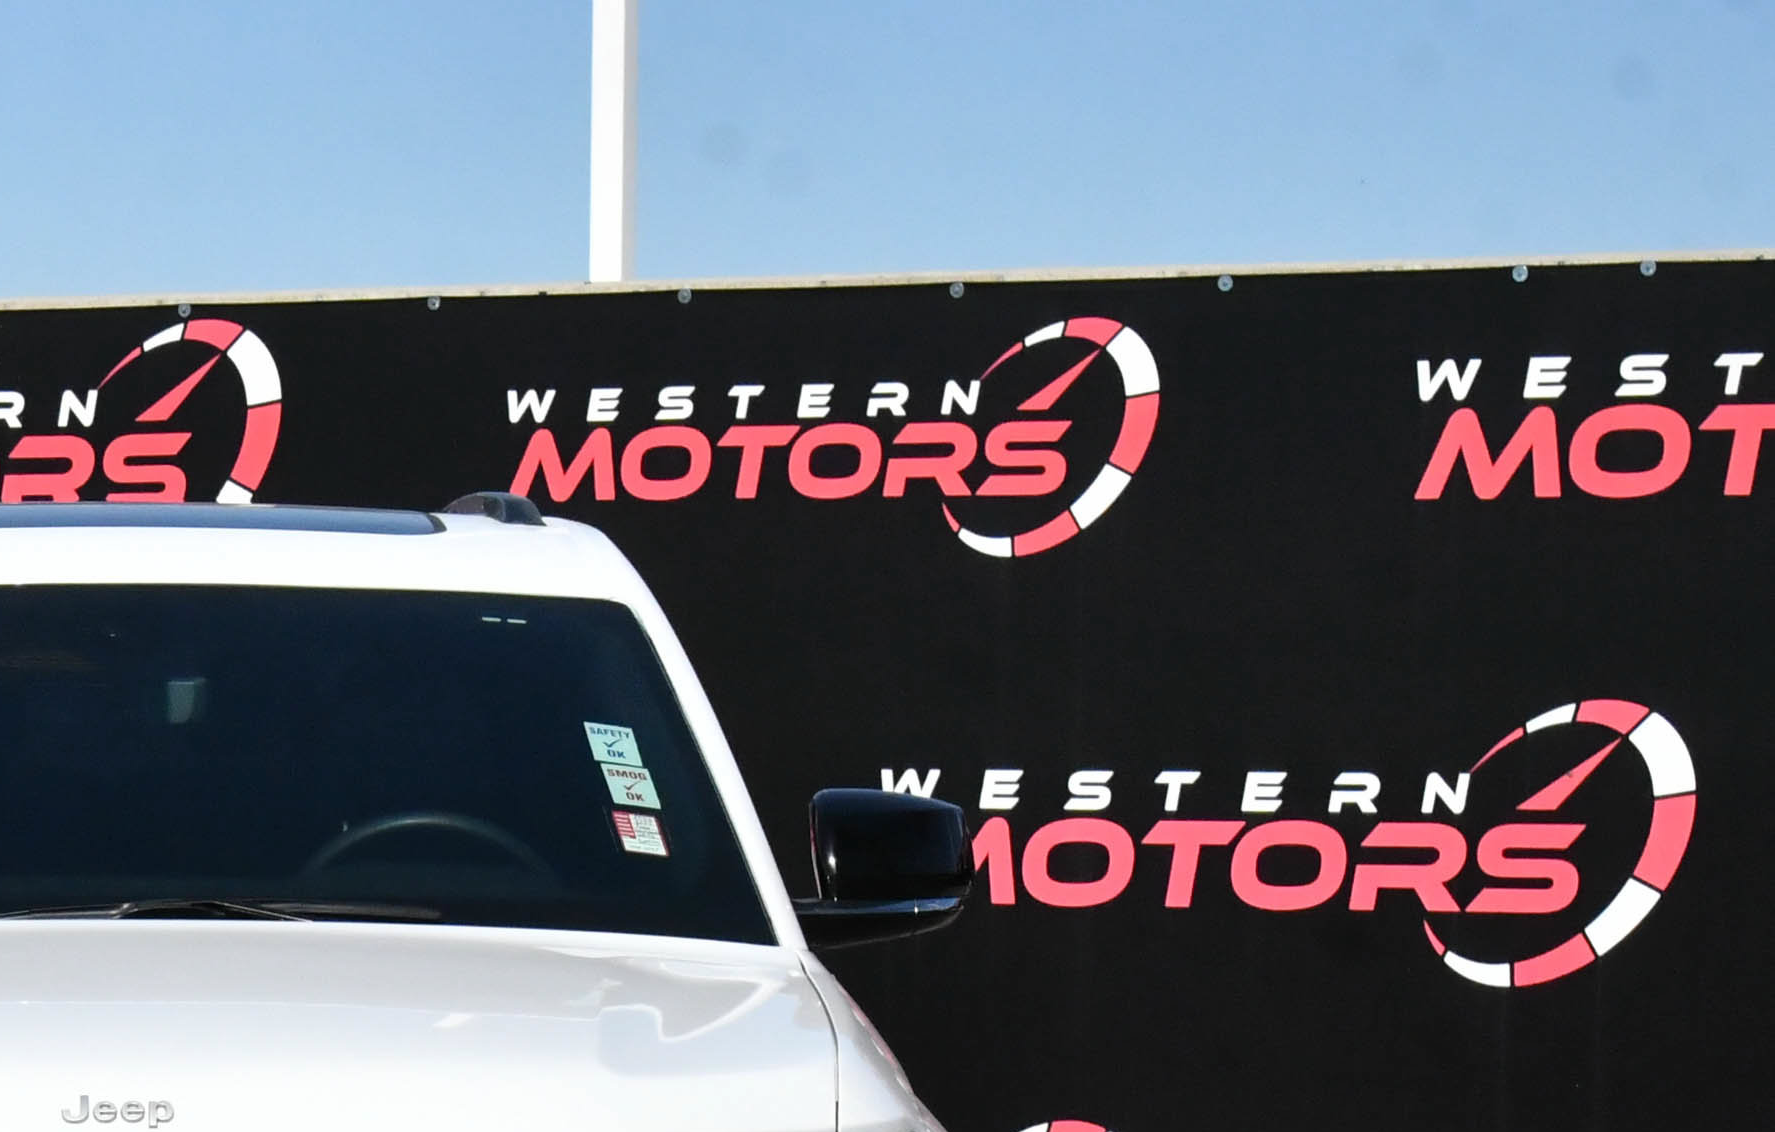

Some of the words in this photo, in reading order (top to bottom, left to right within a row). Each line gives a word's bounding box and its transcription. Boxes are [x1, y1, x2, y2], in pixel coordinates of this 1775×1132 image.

[507, 379, 981, 424] WESTERN
[509, 419, 1073, 502] MOTORS
[588, 726, 631, 739] SAFETY
[607, 749, 626, 759] OK
[606, 768, 648, 781] SMOG
[626, 791, 645, 802] OK
[880, 768, 1471, 815] WESTERN
[61, 1095, 175, 1128] Jeep
